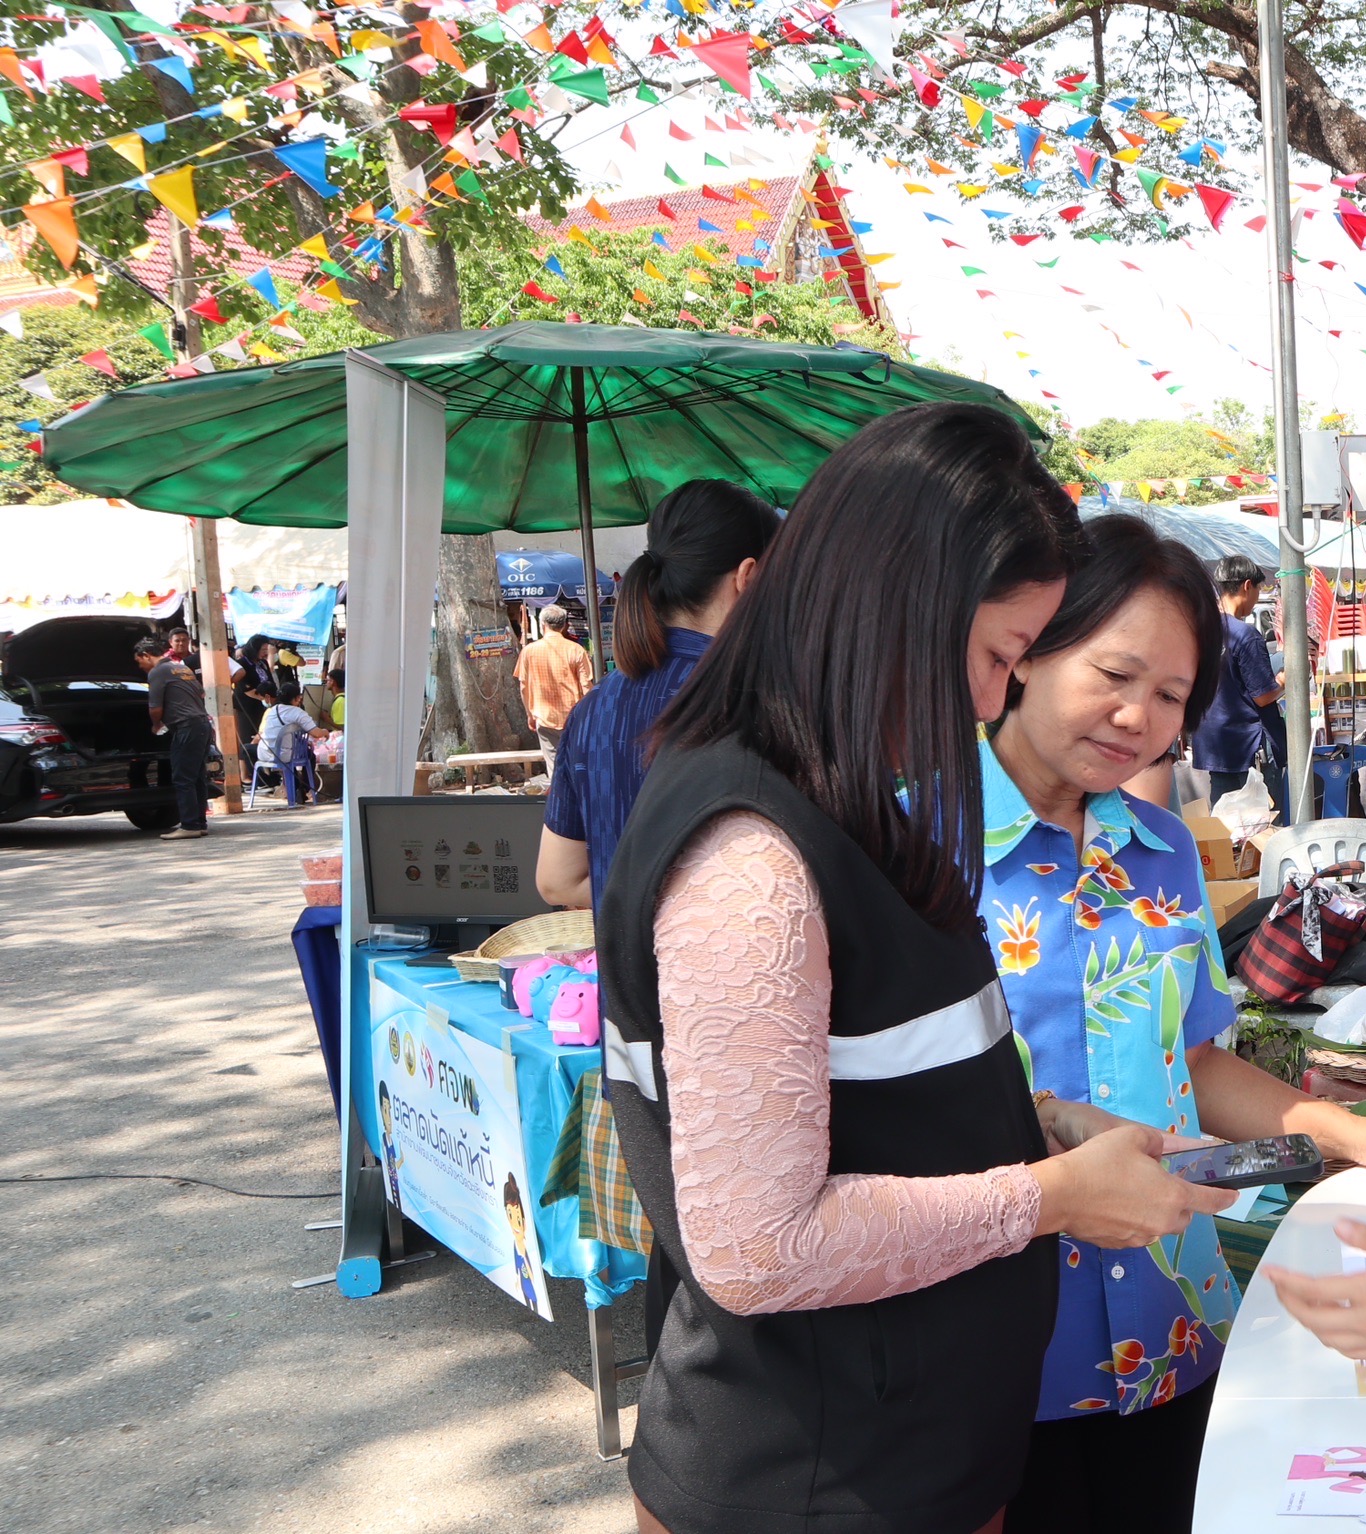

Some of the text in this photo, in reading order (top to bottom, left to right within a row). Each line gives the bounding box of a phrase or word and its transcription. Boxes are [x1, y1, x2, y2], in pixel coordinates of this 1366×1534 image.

[507, 573, 536, 582] OIC
[521, 587, 544, 596] 1186
[392, 1094, 496, 1191] ตลาดนัดแก้หนี้
